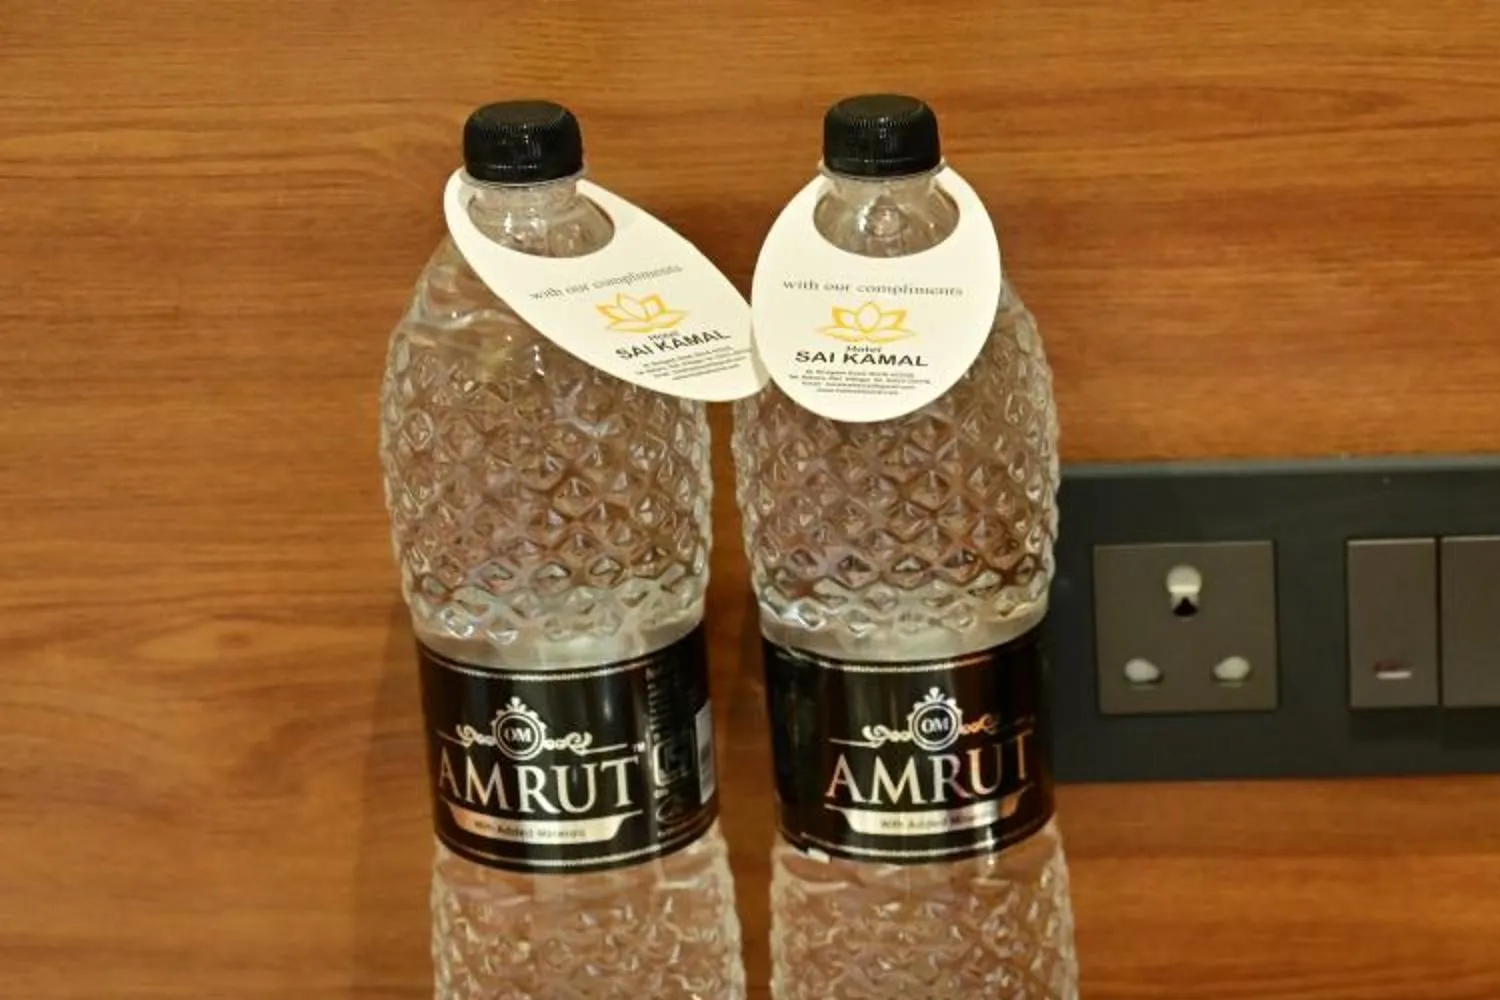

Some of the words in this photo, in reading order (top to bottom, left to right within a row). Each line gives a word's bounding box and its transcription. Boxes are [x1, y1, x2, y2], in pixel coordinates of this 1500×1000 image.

[528, 286, 563, 301] with
[565, 283, 591, 295] our
[591, 264, 685, 287] compliments
[783, 279, 819, 292] with
[824, 282, 850, 293] our
[857, 282, 964, 297] compliments
[615, 343, 654, 361] SAI
[654, 328, 732, 353] KAMAL
[795, 350, 836, 363] SAI
[843, 352, 929, 367] KAMAL
[504, 727, 533, 742] OM
[921, 717, 949, 732] OM
[825, 729, 1034, 805] AMRUT
[439, 745, 639, 815] AMRUT
